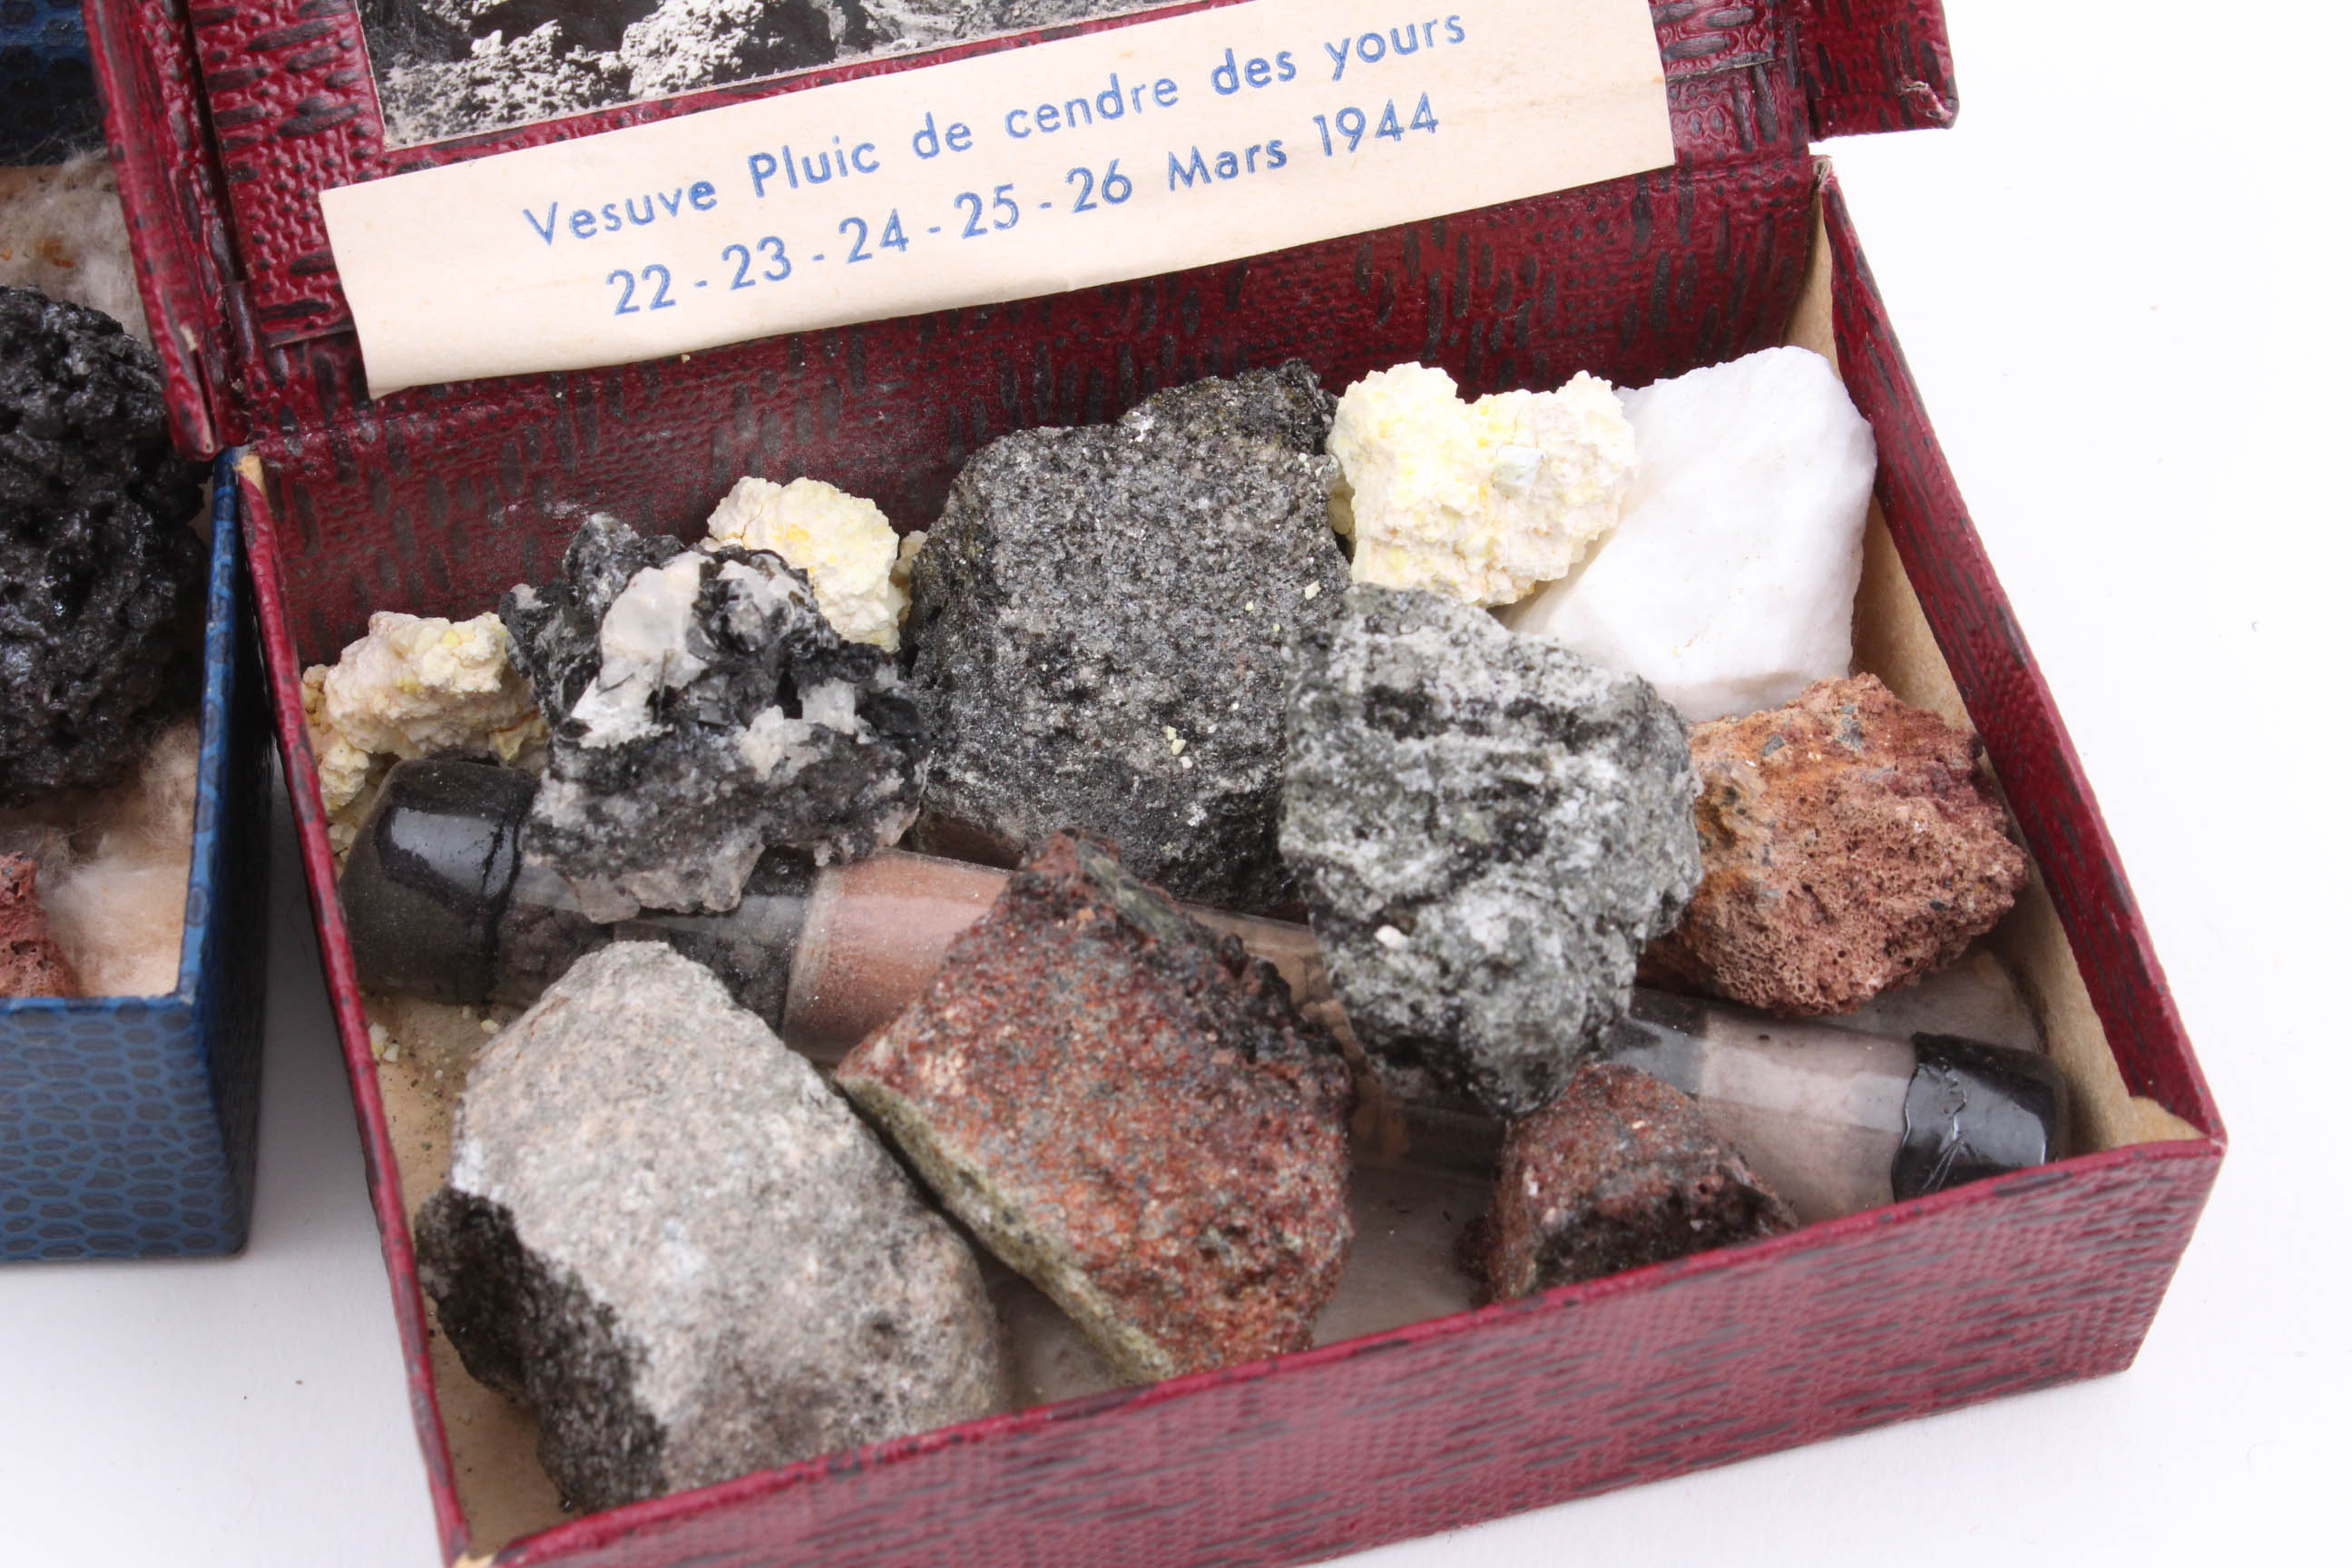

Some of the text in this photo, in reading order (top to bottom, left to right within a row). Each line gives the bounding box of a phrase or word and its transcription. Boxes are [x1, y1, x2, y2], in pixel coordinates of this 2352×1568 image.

[522, 15, 1467, 247] Vesuve Pluic de cendre des yours
[606, 263, 677, 317] 22
[720, 235, 793, 291] 23
[838, 209, 910, 265] 24
[954, 183, 1021, 240] 25
[1066, 159, 1134, 214] 26
[1168, 139, 1289, 192] Mars
[1313, 93, 1440, 158] 1944
